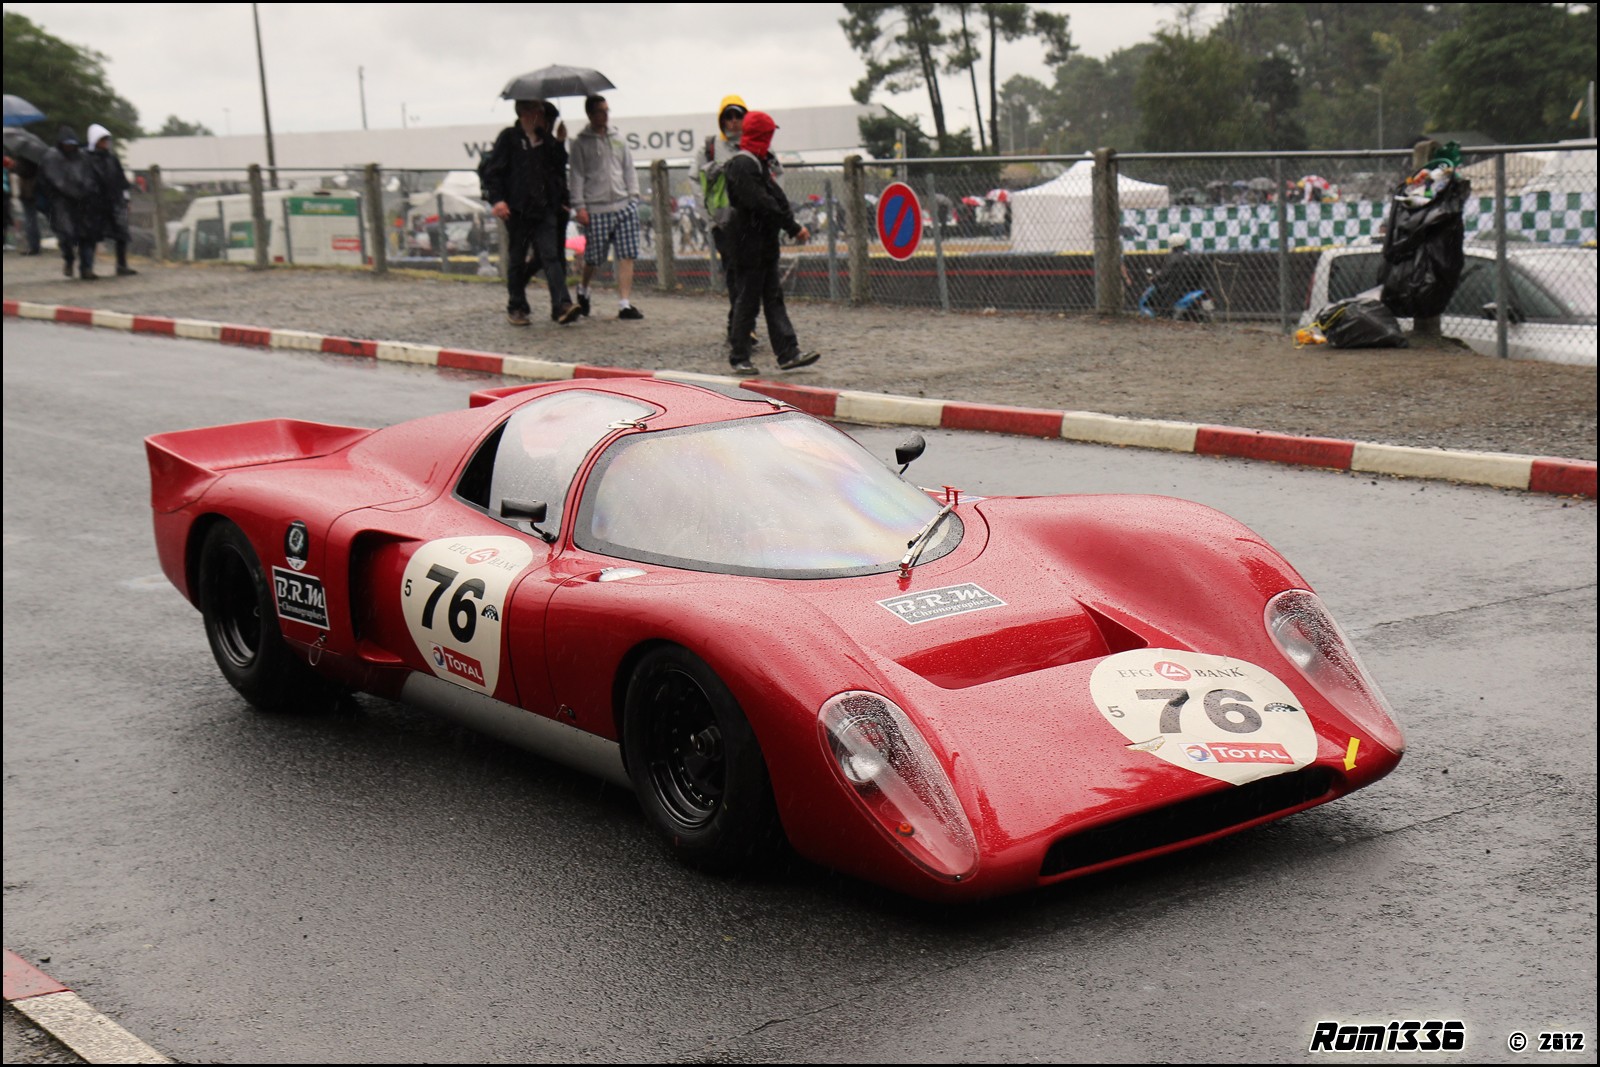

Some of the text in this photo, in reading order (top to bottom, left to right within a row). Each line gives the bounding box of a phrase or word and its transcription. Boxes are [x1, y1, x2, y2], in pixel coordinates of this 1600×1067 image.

[275, 576, 325, 608] B.R.M
[404, 578, 413, 598] 5
[421, 563, 486, 643] 76
[887, 590, 988, 614] B.R.M
[444, 652, 483, 680] TOTAL
[1117, 667, 1244, 679] EFG BANK
[1107, 705, 1126, 719] 5
[1135, 688, 1263, 734] 76
[1211, 746, 1288, 760] TOTAL
